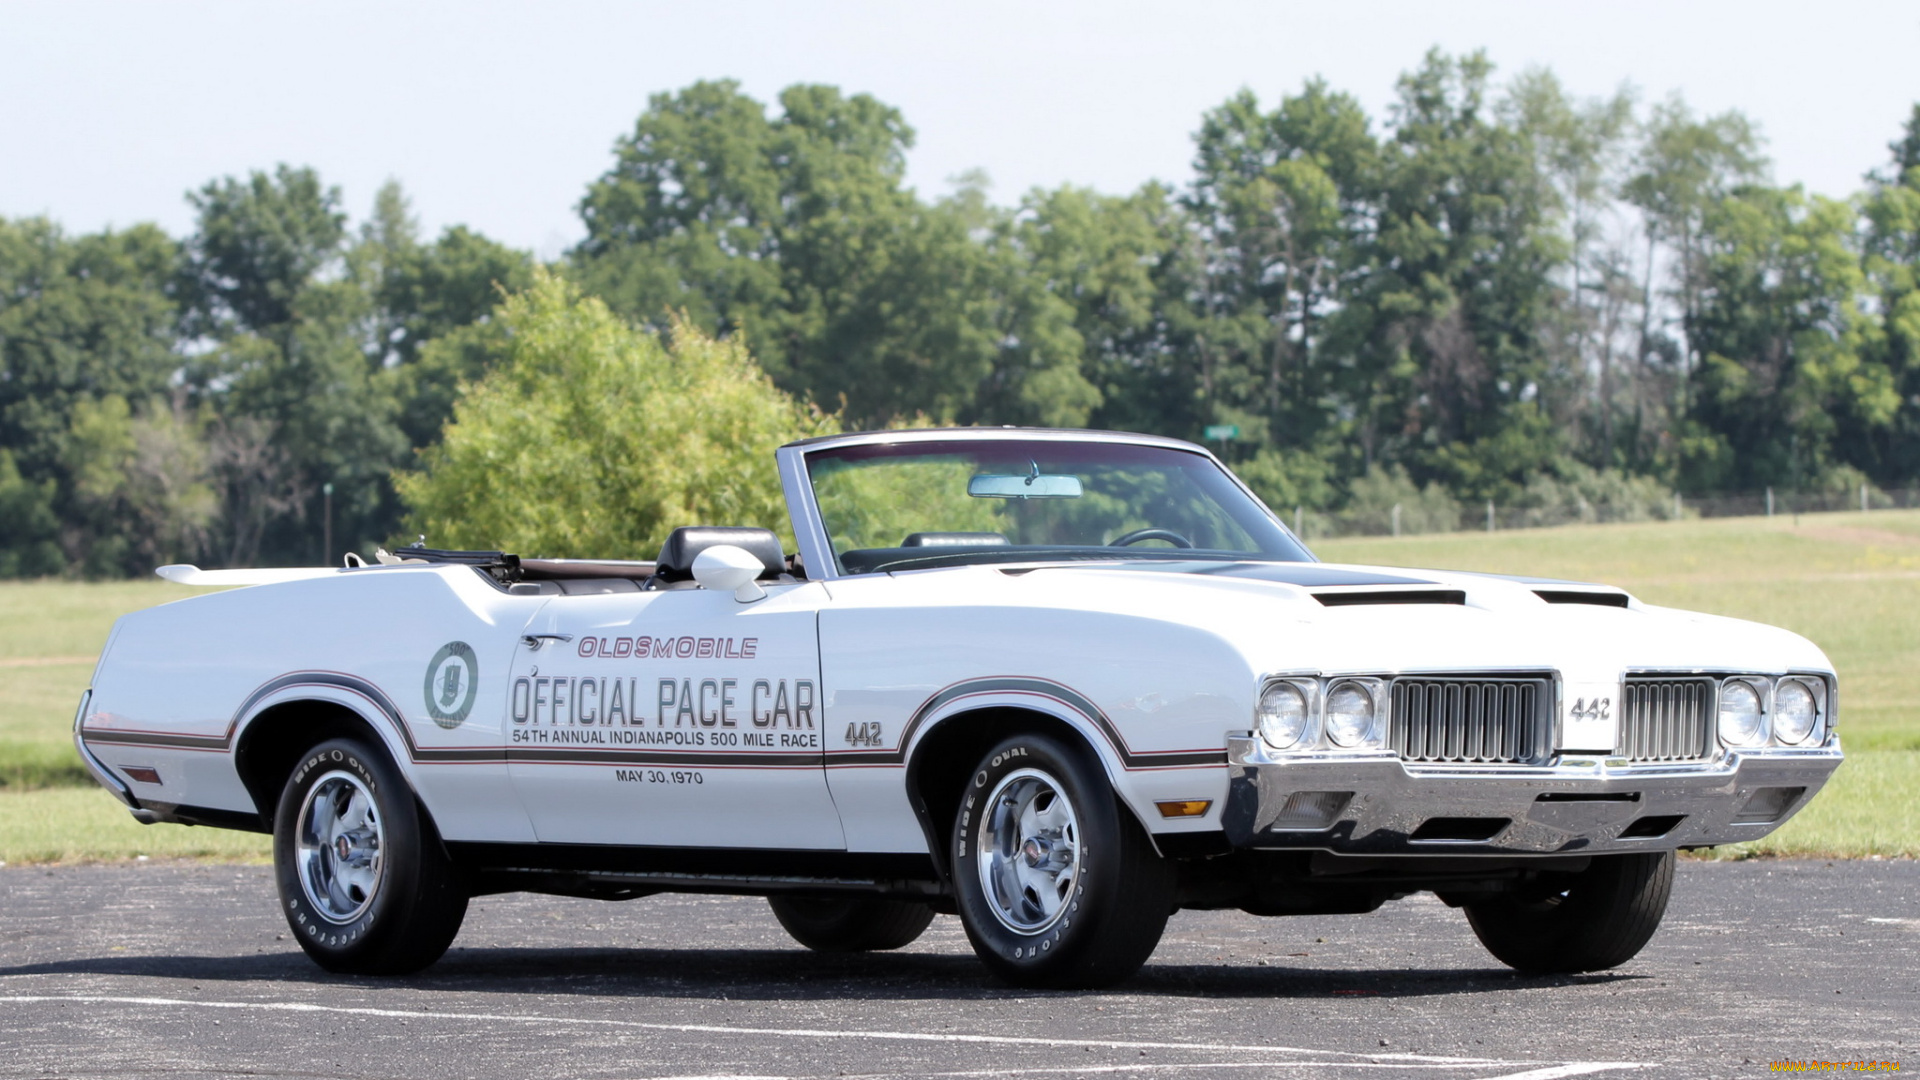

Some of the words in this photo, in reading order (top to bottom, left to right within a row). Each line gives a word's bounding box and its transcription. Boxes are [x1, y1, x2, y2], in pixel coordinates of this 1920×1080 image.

[578, 635, 759, 659] OLDSMOBILE
[512, 675, 645, 728] OFFICIAL
[657, 677, 738, 730] PACE
[751, 678, 815, 731] CAR
[1569, 697, 1610, 722] 442
[512, 729, 548, 743] 54TH
[552, 730, 606, 744] ANNUAL
[609, 731, 704, 746] INDIANAPOLIS
[710, 732, 737, 747] 500
[743, 733, 774, 747] MILE
[781, 734, 818, 748] RACE
[844, 721, 883, 747] 442
[294, 752, 327, 784] WIDE
[348, 757, 377, 793] OVAL
[615, 769, 643, 782] MAY
[958, 794, 976, 858] WIDE
[991, 747, 1029, 768] OVAL
